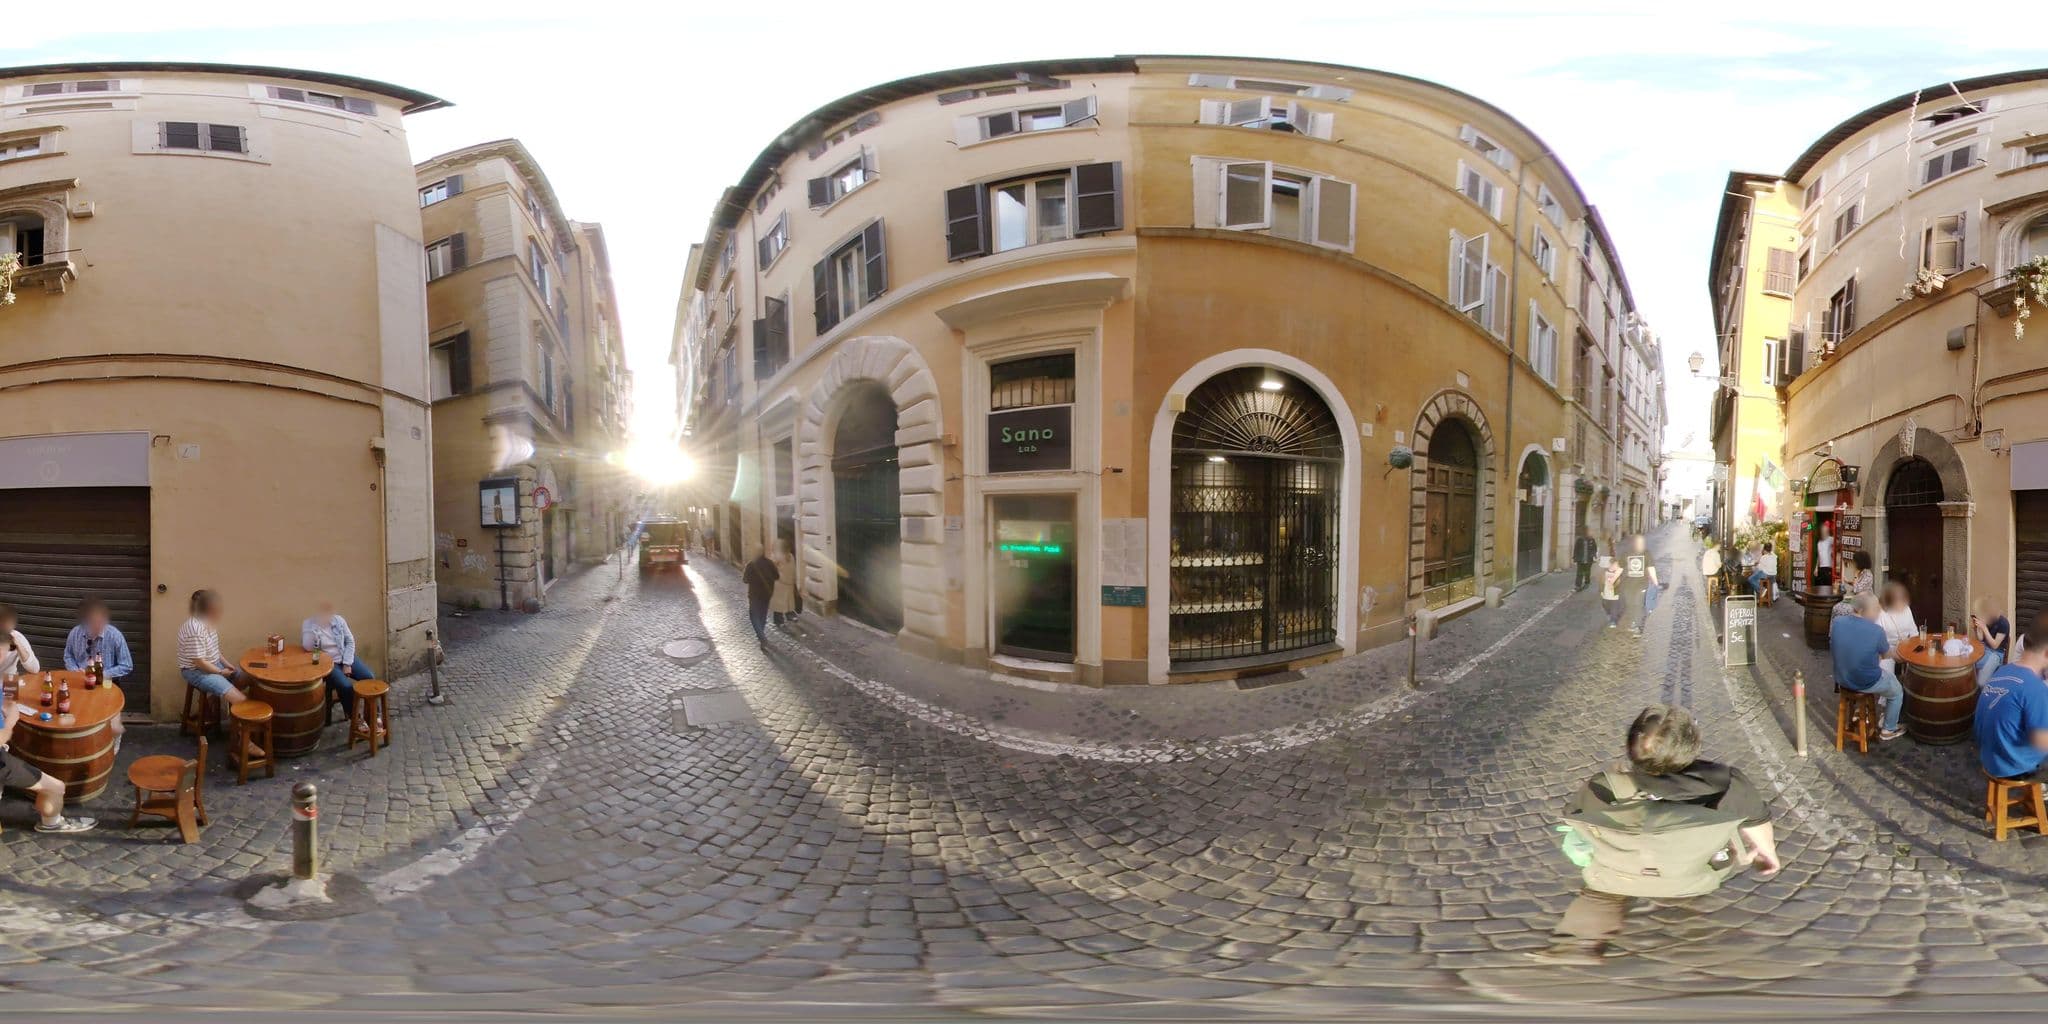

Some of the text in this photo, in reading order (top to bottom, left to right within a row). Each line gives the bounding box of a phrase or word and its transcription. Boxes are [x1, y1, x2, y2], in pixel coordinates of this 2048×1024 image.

[1001, 427, 1053, 443] Sano
[1730, 608, 1754, 618] APEROL
[1729, 618, 1754, 628] SPRITZ
